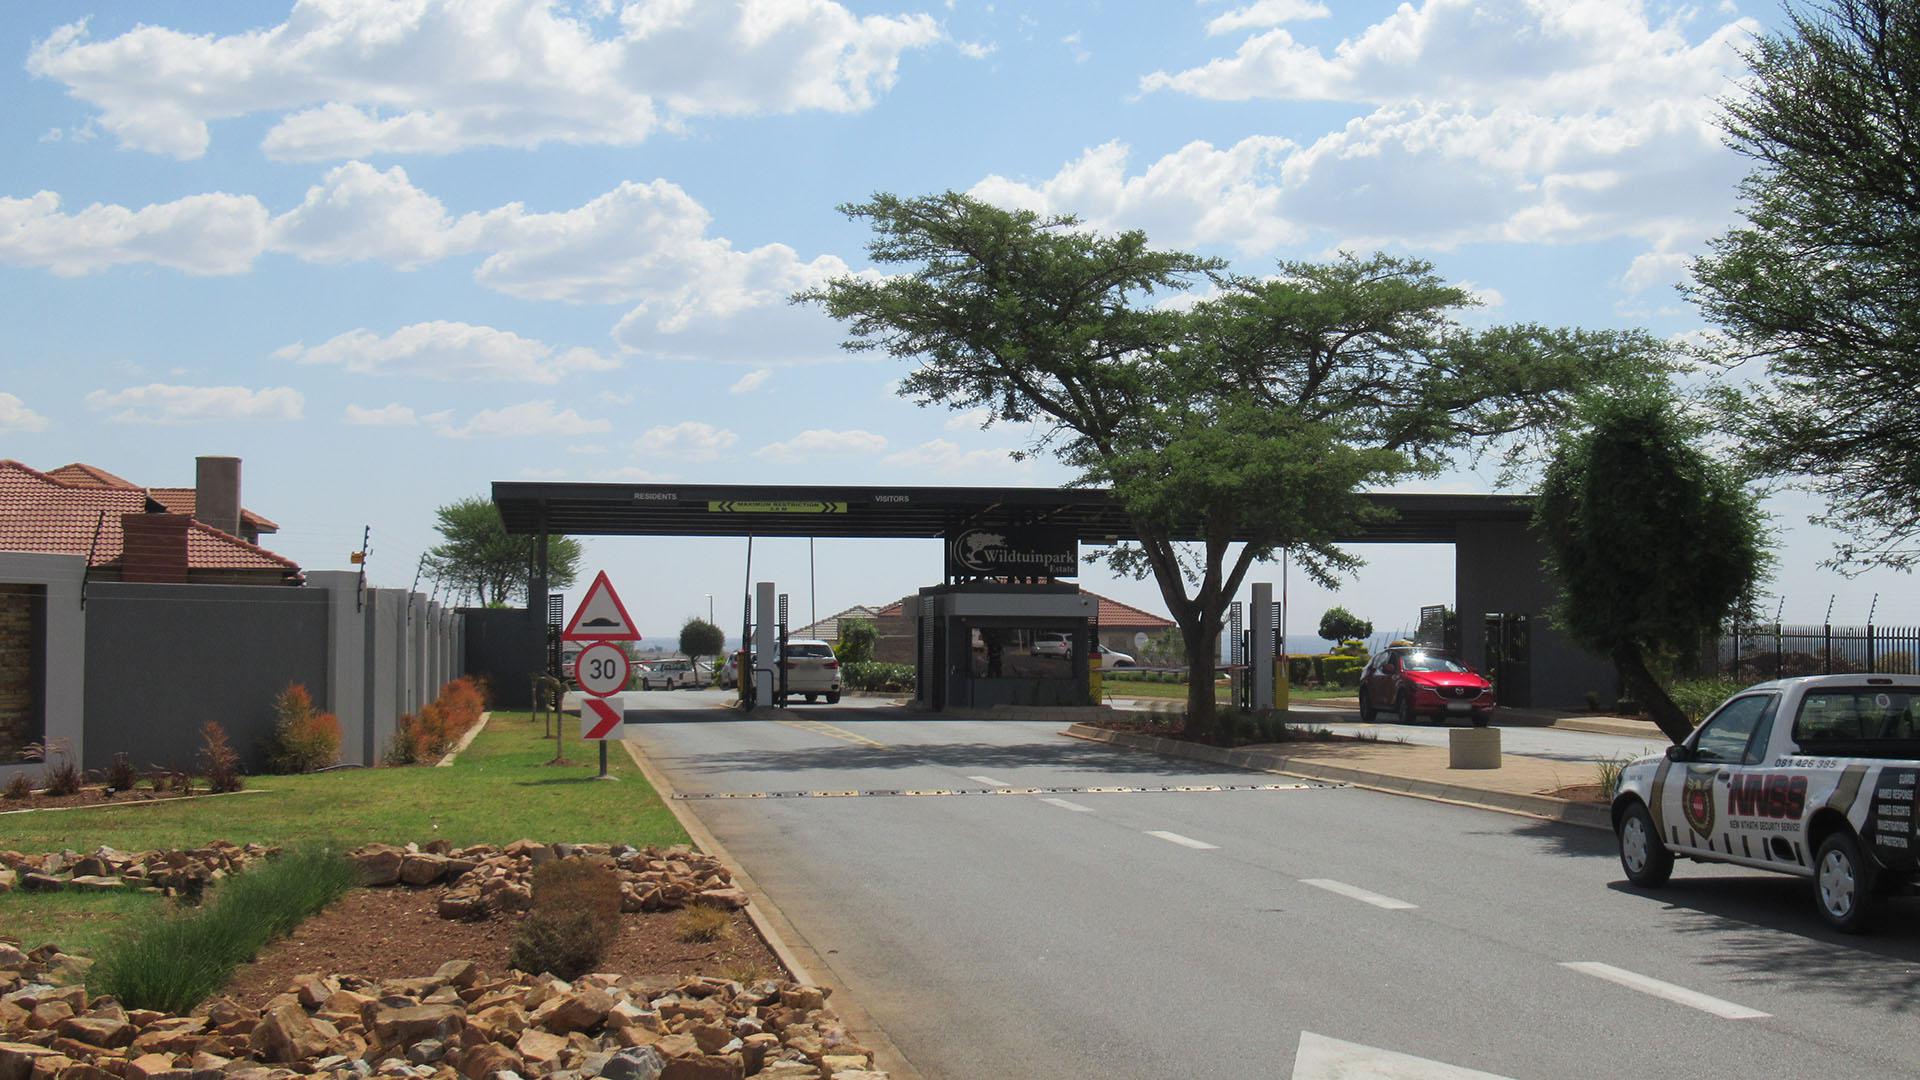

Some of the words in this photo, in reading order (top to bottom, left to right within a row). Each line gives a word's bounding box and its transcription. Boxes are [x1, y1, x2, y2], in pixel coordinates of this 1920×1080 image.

[634, 492, 678, 500] RESIDENTS
[874, 495, 910, 503] VISITORS
[984, 549, 1075, 567] Wildtuinpark
[1049, 564, 1075, 574] Estate
[590, 658, 616, 680] 30
[1774, 758, 1794, 768] 081
[1728, 773, 1808, 820] NNSS
[1879, 788, 1892, 800] ARMED
[1893, 789, 1914, 801] RESPONSE
[1878, 804, 1892, 816] ARMED
[1730, 820, 1740, 829] NEW
[1760, 821, 1780, 831] SECURITY
[1883, 835, 1909, 849] PROTECTION
